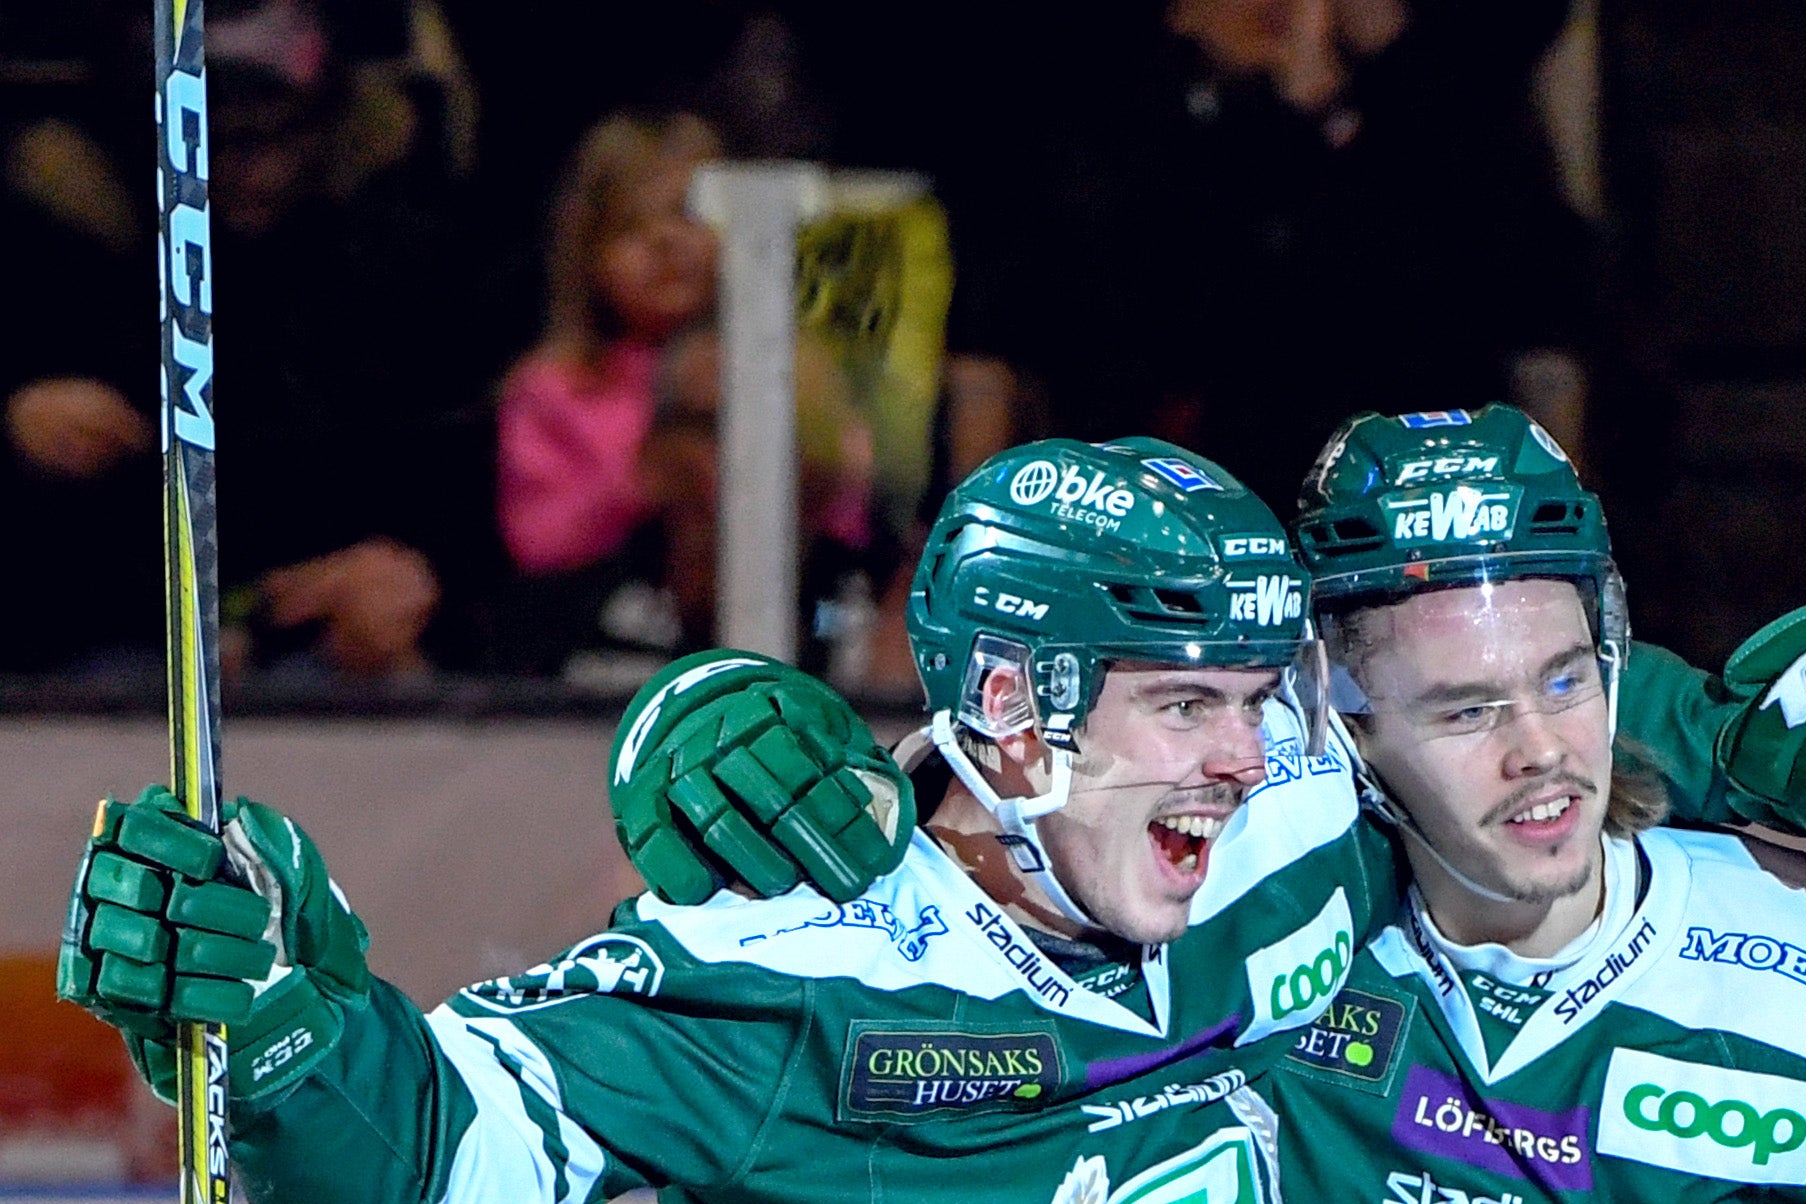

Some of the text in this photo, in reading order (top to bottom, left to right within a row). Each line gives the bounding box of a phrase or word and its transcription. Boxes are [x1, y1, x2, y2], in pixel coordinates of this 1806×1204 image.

[166, 65, 215, 452] CCM
[1054, 464, 1136, 518] bke
[1049, 501, 1122, 533] TELECOM
[1223, 537, 1286, 557] CCM
[1042, 730, 1072, 743] CCM
[1471, 974, 1542, 1006] CCM
[1478, 997, 1523, 1025] SHL
[867, 1042, 1044, 1077] GRÖNSAKS
